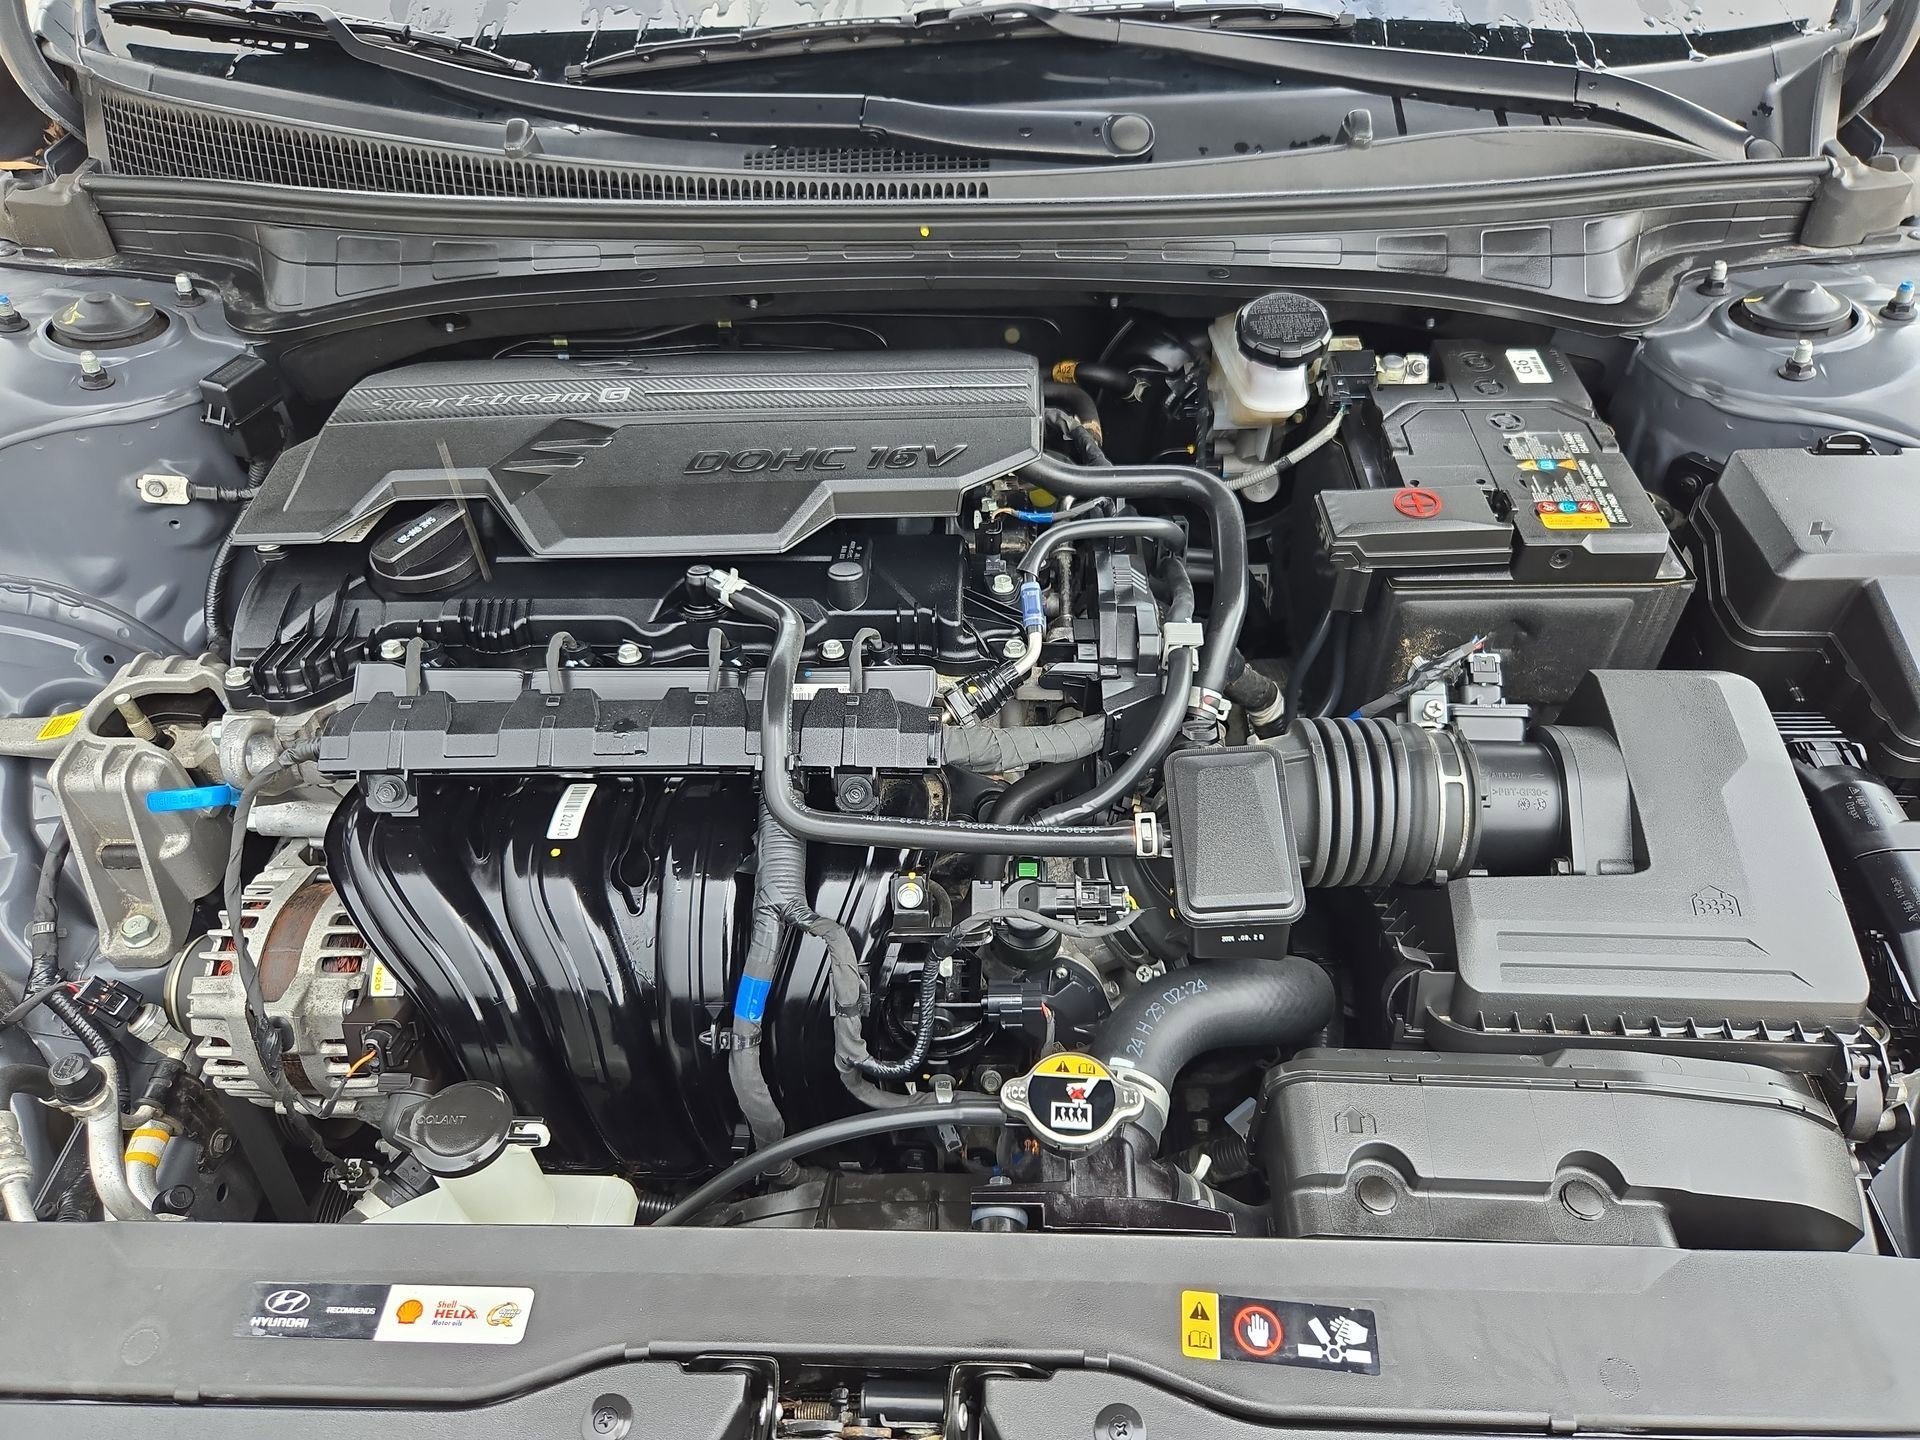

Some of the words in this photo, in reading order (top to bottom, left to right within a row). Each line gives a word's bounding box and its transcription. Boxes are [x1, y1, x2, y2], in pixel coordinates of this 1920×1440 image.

[363, 391, 591, 413] Smartstream
[683, 446, 856, 474] DOHC
[867, 444, 968, 469] 16V
[1162, 978, 1208, 1008] 02:24
[1135, 1020, 1153, 1036] H
[1126, 1037, 1147, 1059] 24
[326, 1305, 376, 1315] RECOMMENDS
[437, 1300, 457, 1309] Shell
[434, 1308, 477, 1319] HELIX
[250, 1316, 309, 1329] HYUNDAI
[431, 1319, 451, 1327] Motor
